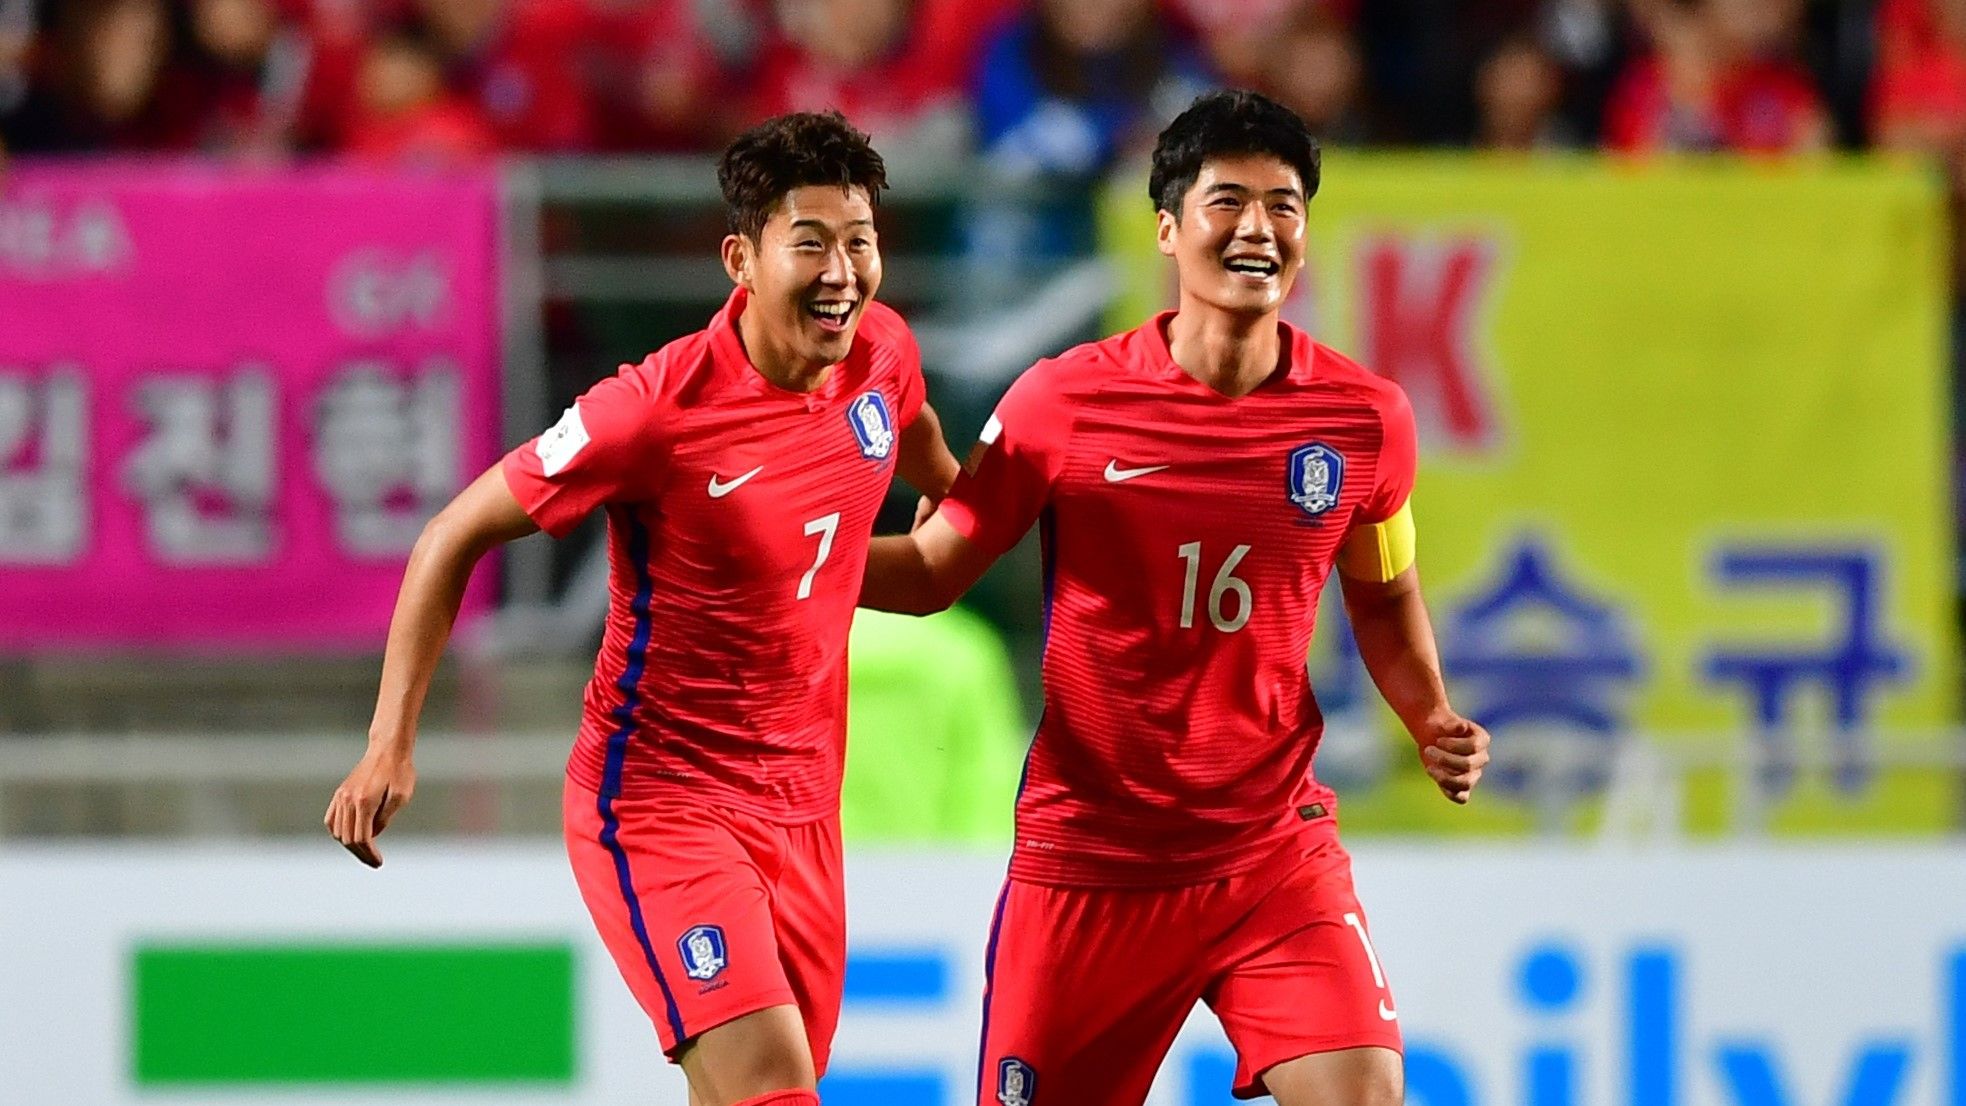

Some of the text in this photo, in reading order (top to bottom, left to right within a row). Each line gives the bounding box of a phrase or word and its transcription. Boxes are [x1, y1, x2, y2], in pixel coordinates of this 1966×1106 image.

[796, 511, 841, 601] 7
[1178, 541, 1252, 633] 16
[1325, 542, 1908, 796] 승규
